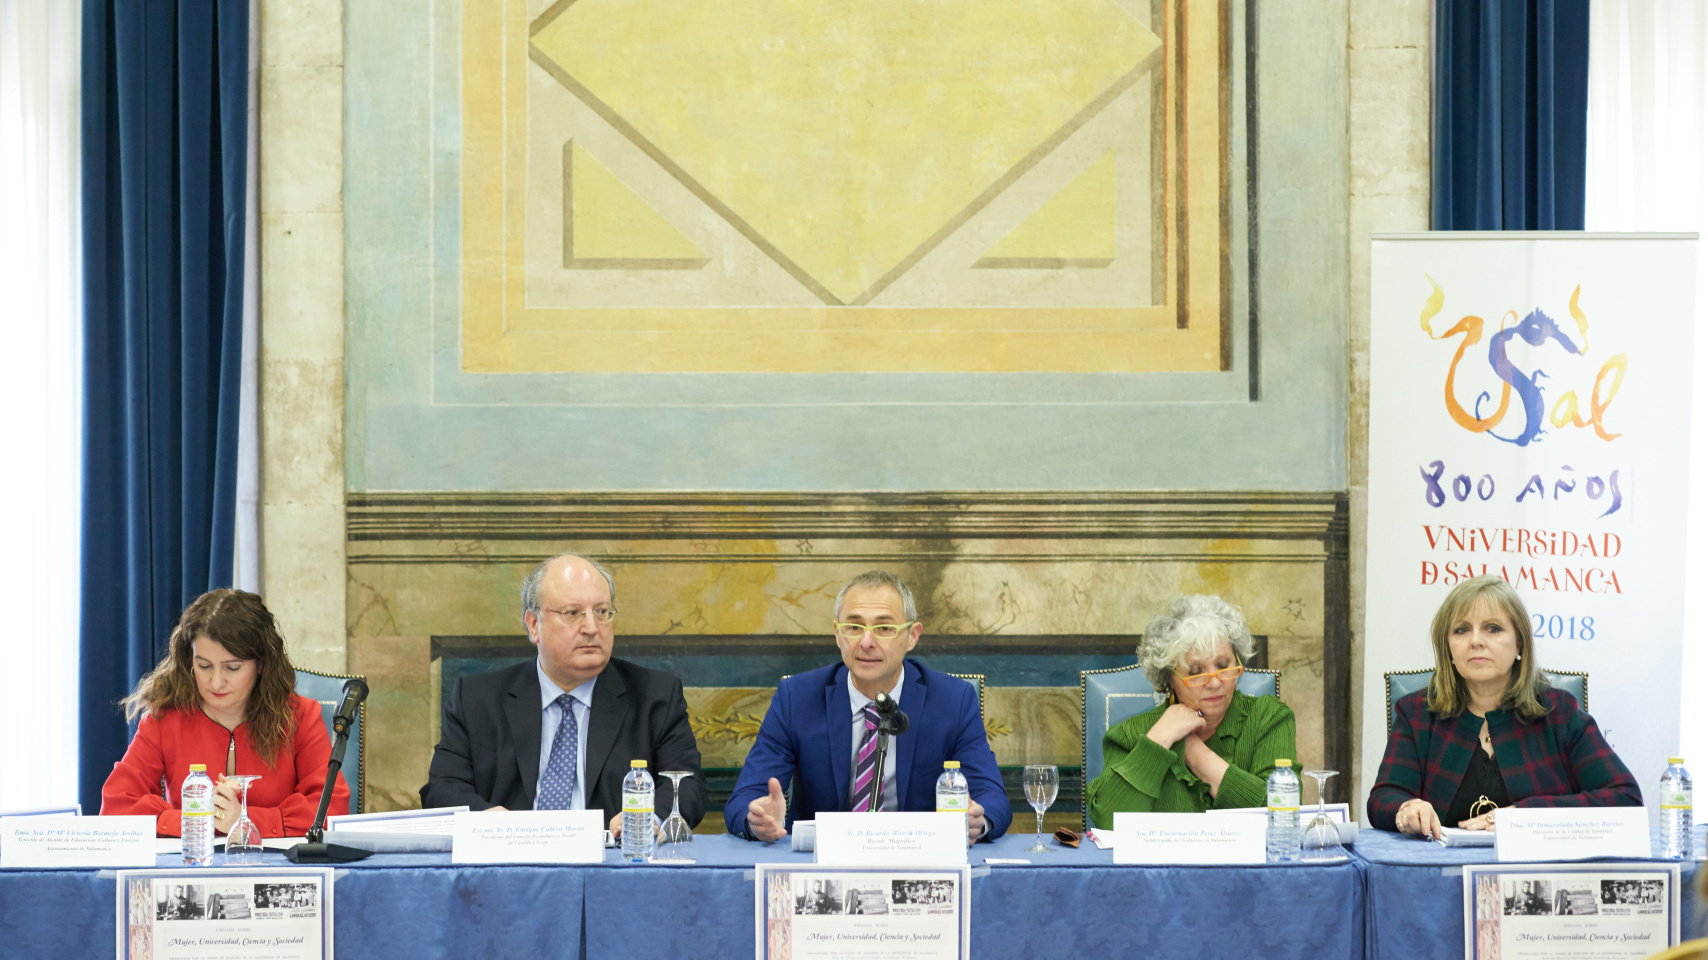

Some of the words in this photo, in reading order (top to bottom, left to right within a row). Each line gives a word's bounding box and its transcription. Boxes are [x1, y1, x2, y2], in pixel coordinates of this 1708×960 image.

[1419, 460, 1495, 508] 800
[1515, 464, 1623, 519] AÑOS
[1532, 613, 1596, 641] 2018
[168, 938, 197, 947] Mujer,
[198, 938, 241, 946] Universidad,
[242, 937, 266, 946] Ciencia
[272, 936, 304, 946] Sociedad
[806, 933, 835, 942] Mujer,
[837, 932, 878, 941] Universidad,
[879, 933, 903, 942] Ciencia
[909, 932, 941, 942] Sociedad
[1515, 933, 1545, 942] Mujer,
[1547, 933, 1588, 941] Universidad,
[1589, 933, 1613, 942] Ciencia
[1620, 933, 1651, 942] Sociedad
